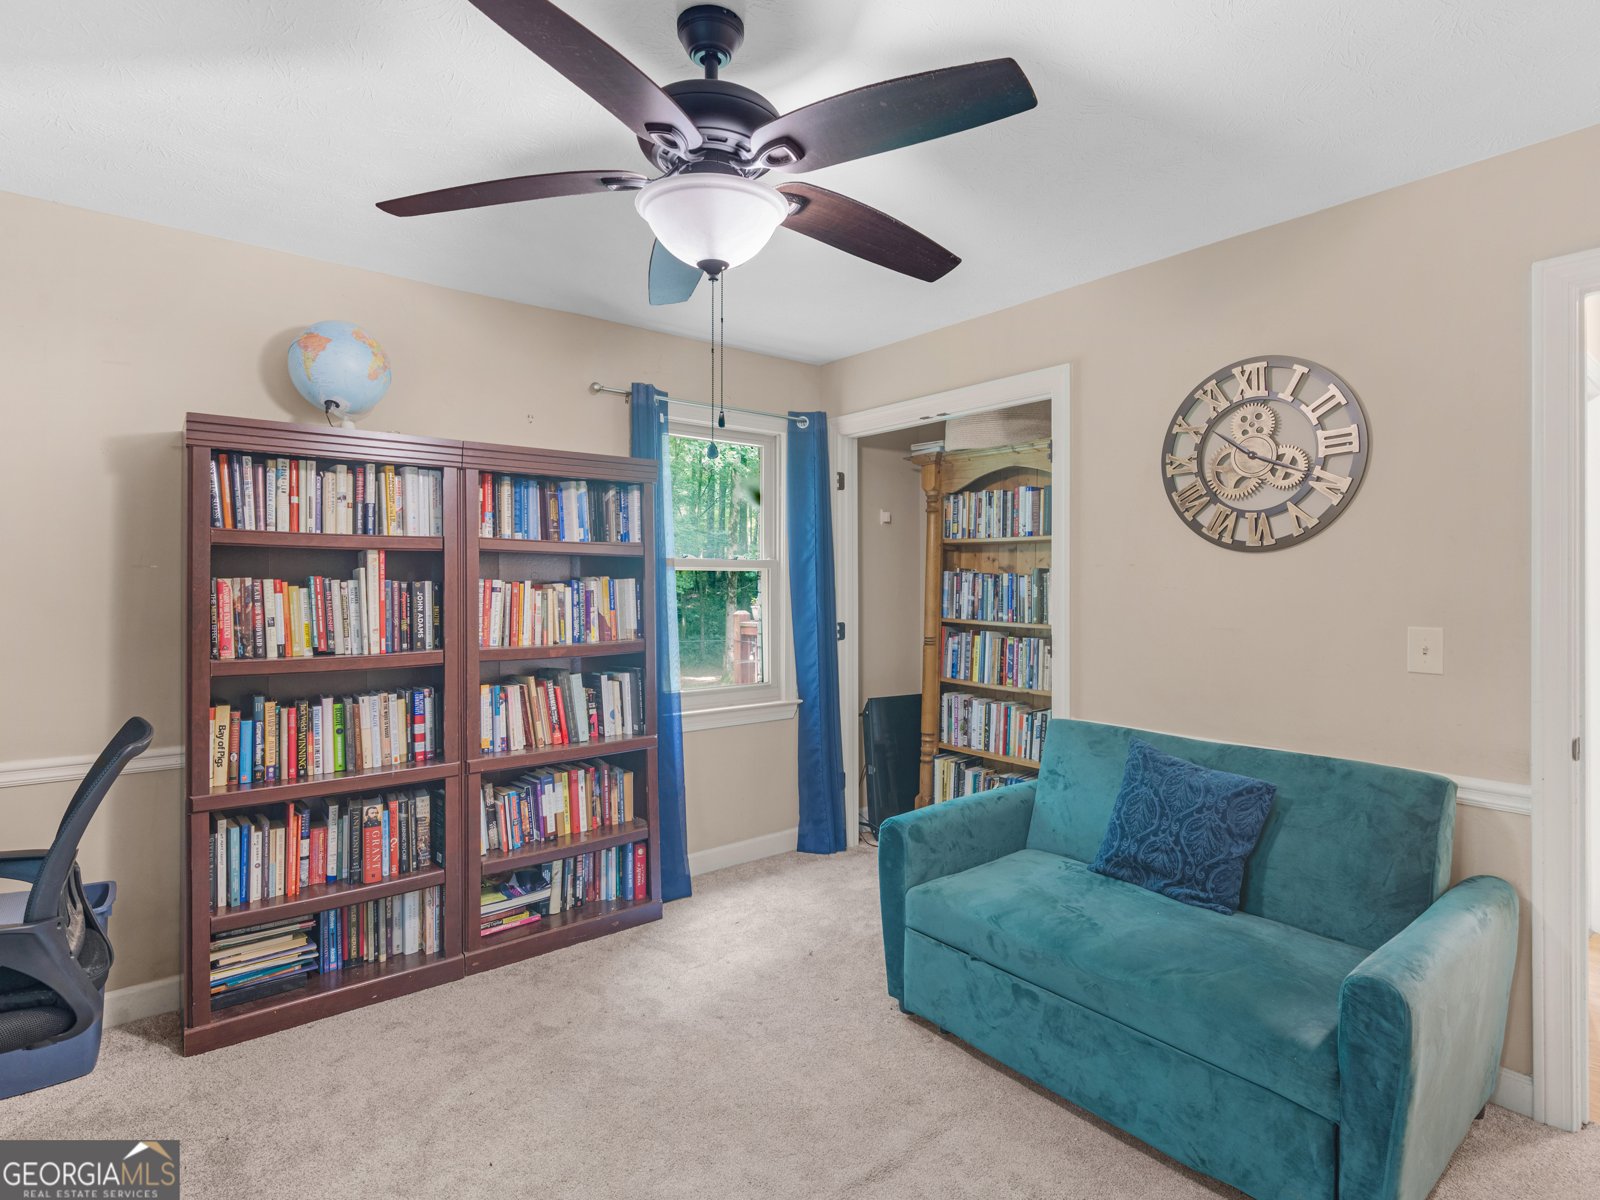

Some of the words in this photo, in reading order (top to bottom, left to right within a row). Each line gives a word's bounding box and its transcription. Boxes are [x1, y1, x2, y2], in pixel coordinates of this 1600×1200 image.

[1194, 379, 1231, 419] XI
[1232, 361, 1269, 402] XII
[1277, 364, 1311, 402] I
[1300, 383, 1348, 426] II
[1172, 416, 1209, 443] X
[1316, 424, 1360, 458] III
[1166, 453, 1198, 478] IX
[1172, 478, 1210, 521] VIII
[1309, 466, 1353, 506] IV
[1202, 503, 1238, 544] VII
[1245, 512, 1277, 547] VI
[1287, 501, 1320, 537] V
[255, 615, 263, 647] WOODWARD
[326, 600, 334, 632] LEADERSHIP
[216, 725, 227, 740] Bay
[218, 742, 226, 750] of
[214, 750, 225, 768] Pigs
[298, 732, 306, 770] WINNING
[372, 830, 380, 870] GRANT
